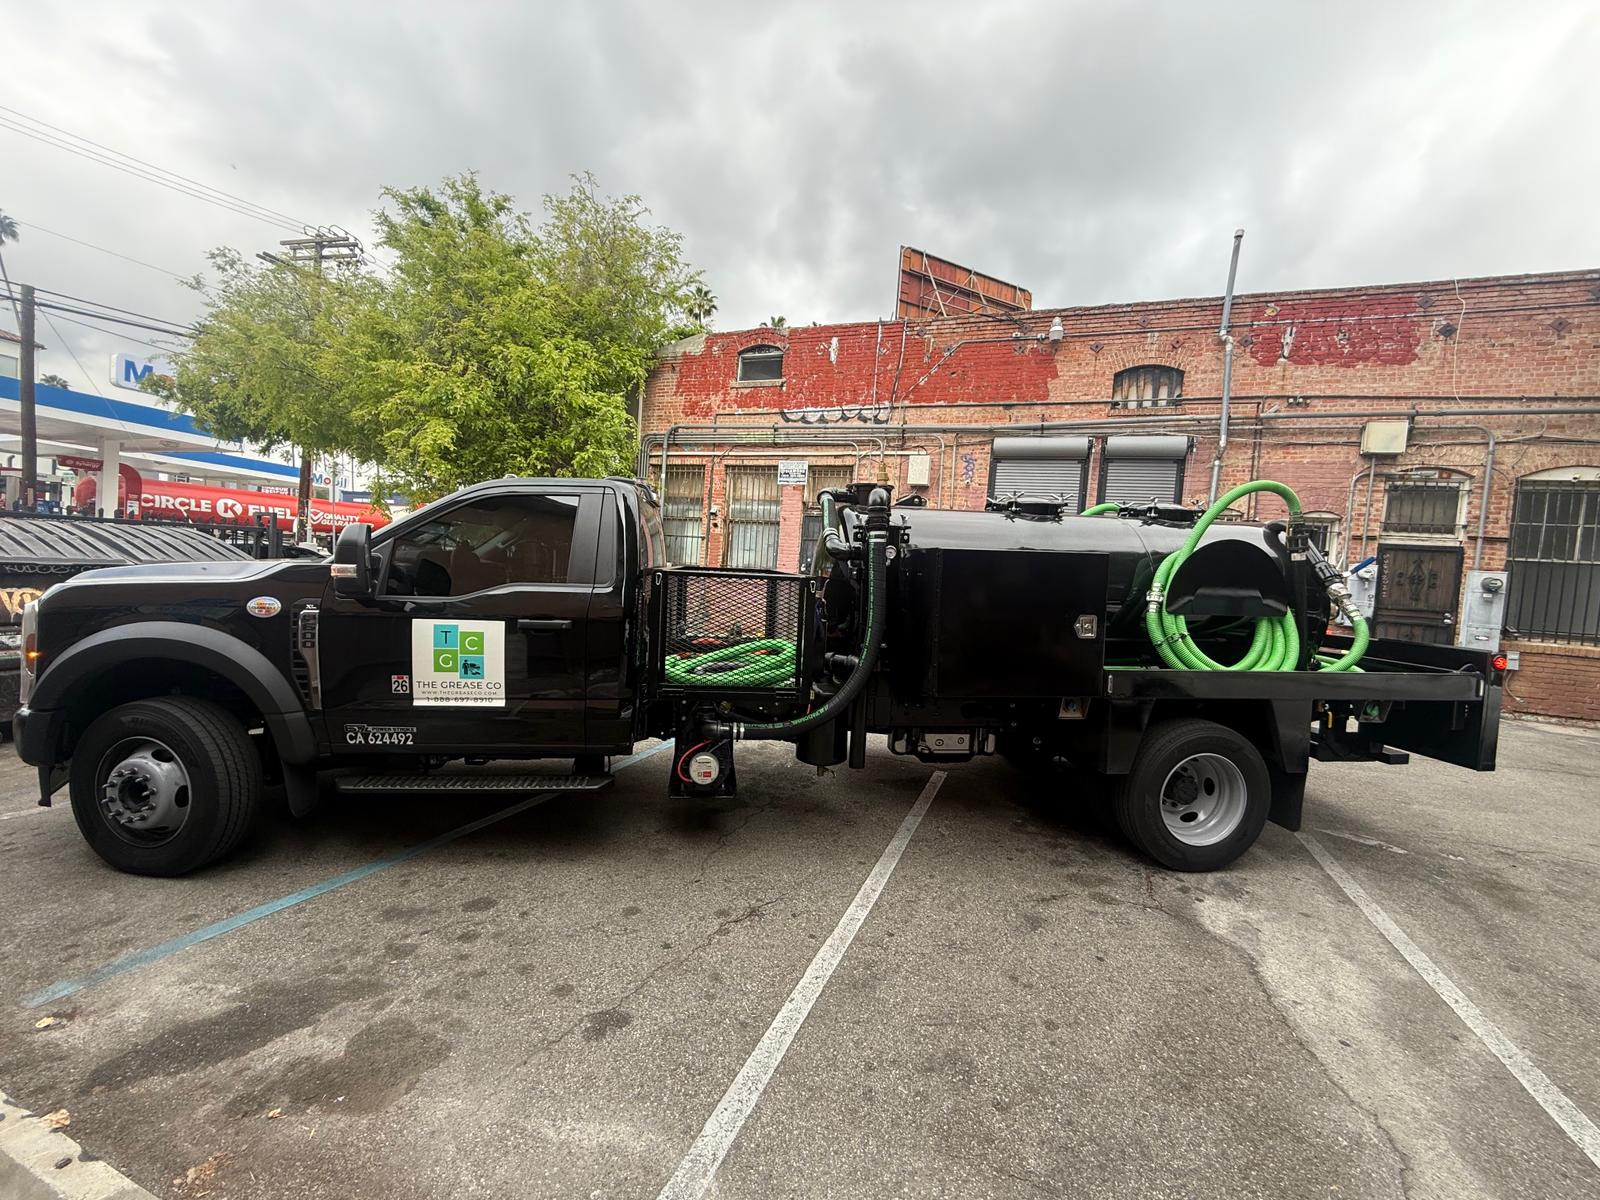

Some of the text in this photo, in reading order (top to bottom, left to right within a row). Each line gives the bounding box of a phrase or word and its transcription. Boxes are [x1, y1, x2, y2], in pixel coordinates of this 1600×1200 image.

[141, 494, 212, 513] CIRCLE
[219, 500, 242, 518] K
[248, 504, 297, 520] FUEL
[323, 512, 360, 522] QUALITY
[440, 630, 451, 645] T
[465, 636, 479, 651] C
[439, 653, 453, 668] G
[393, 680, 408, 693] 26
[416, 680, 502, 690] THE GREASE CO
[346, 732, 414, 745] CA 624492
